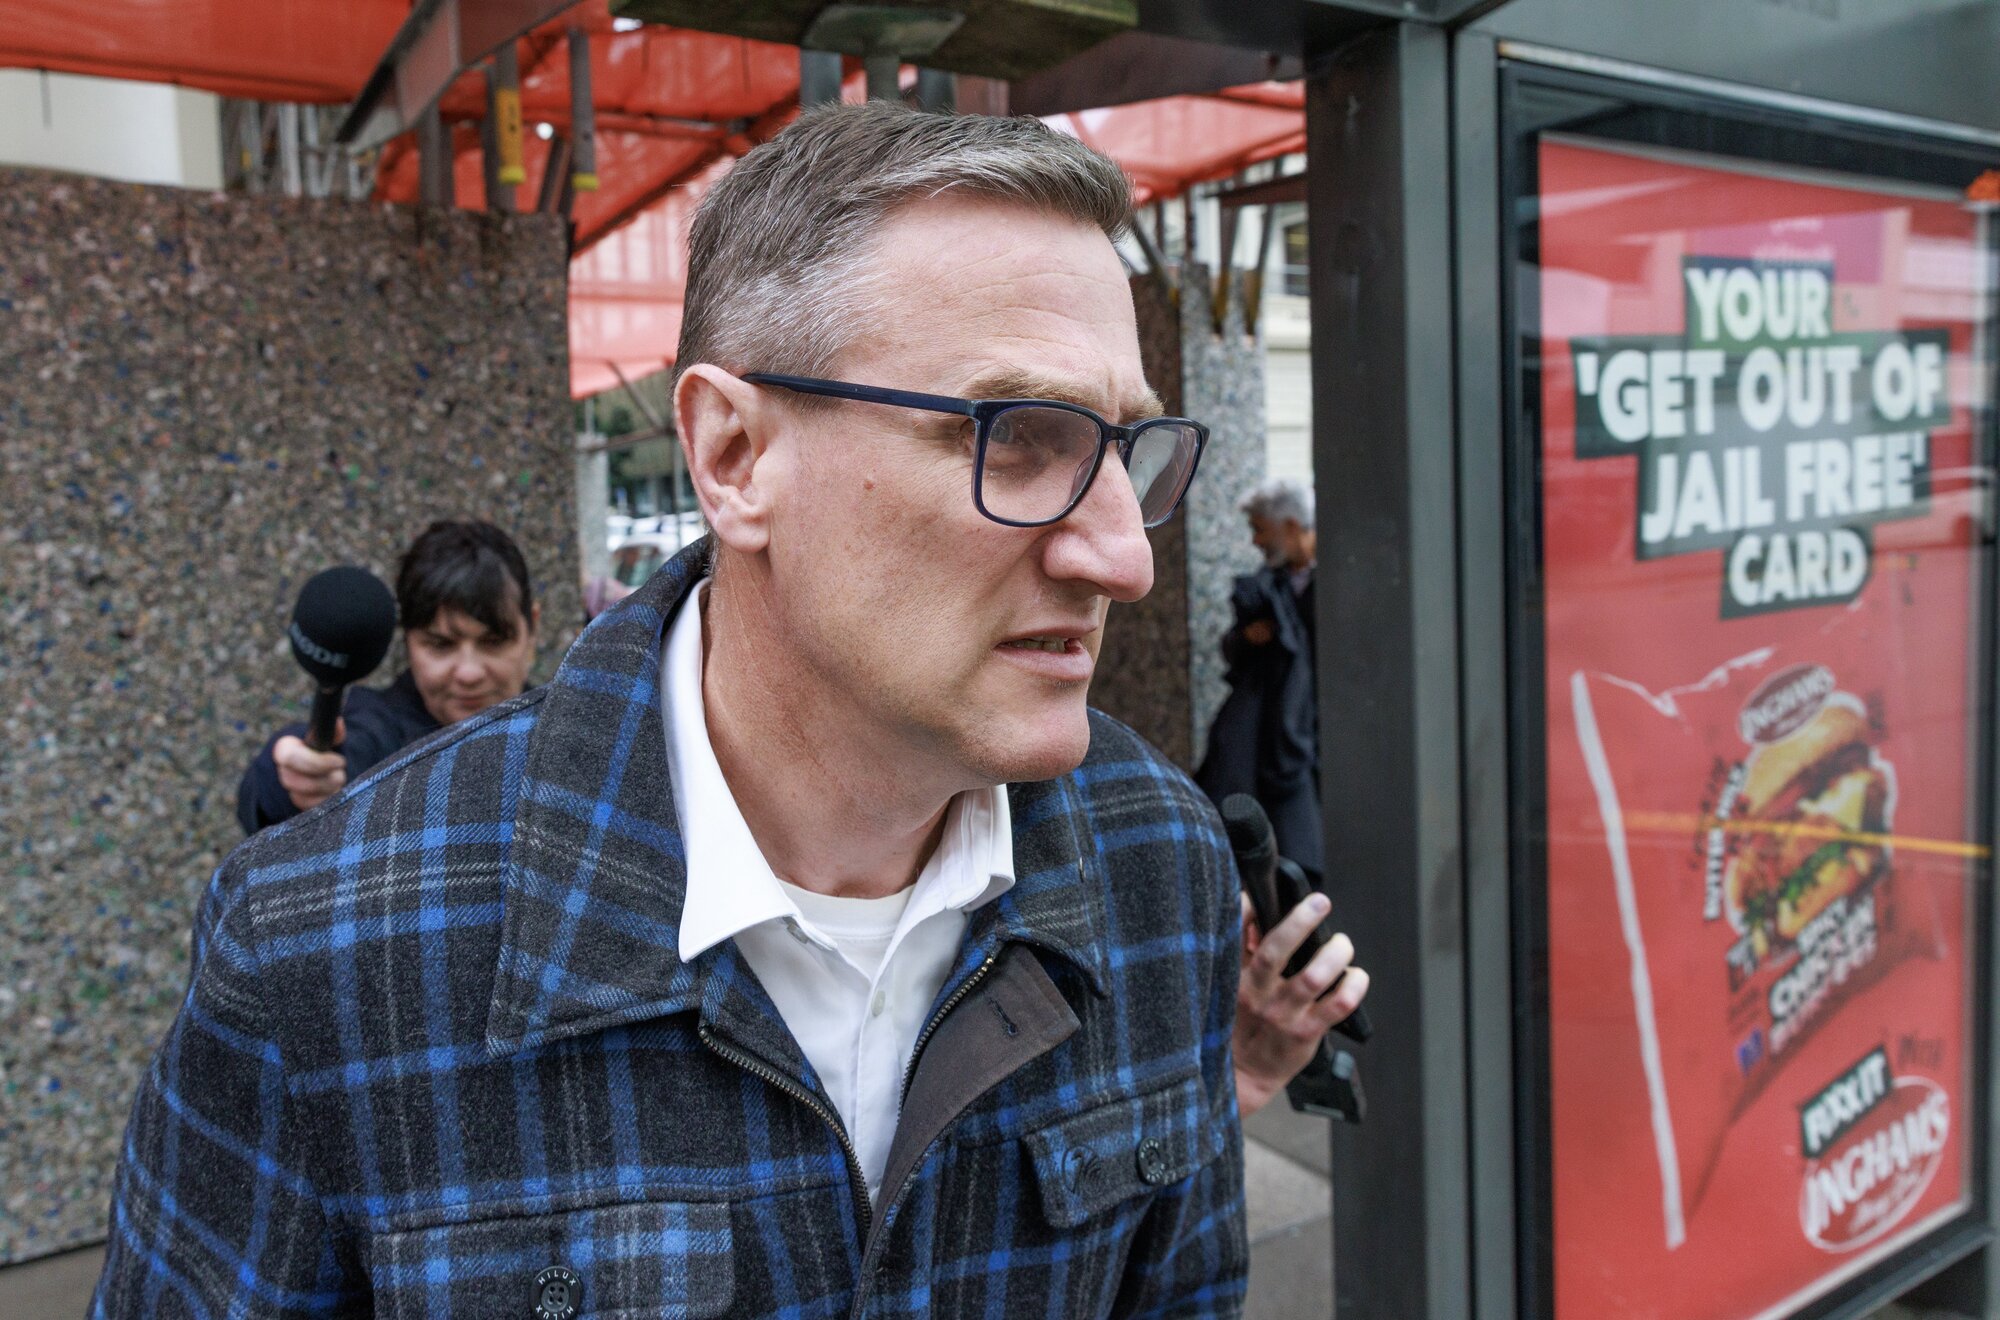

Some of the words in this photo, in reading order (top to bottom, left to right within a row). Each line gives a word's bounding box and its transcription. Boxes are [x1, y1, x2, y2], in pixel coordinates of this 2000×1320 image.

[1686, 268, 1830, 340] YOUR
[1578, 349, 1725, 441] 'GET
[1738, 347, 1860, 430] OUT
[1872, 342, 1941, 420] OF
[1641, 446, 1774, 542] JAIL
[1785, 431, 1926, 521] FREE'
[1728, 530, 1867, 605] CARD
[538, 1270, 576, 1285] HILUX
